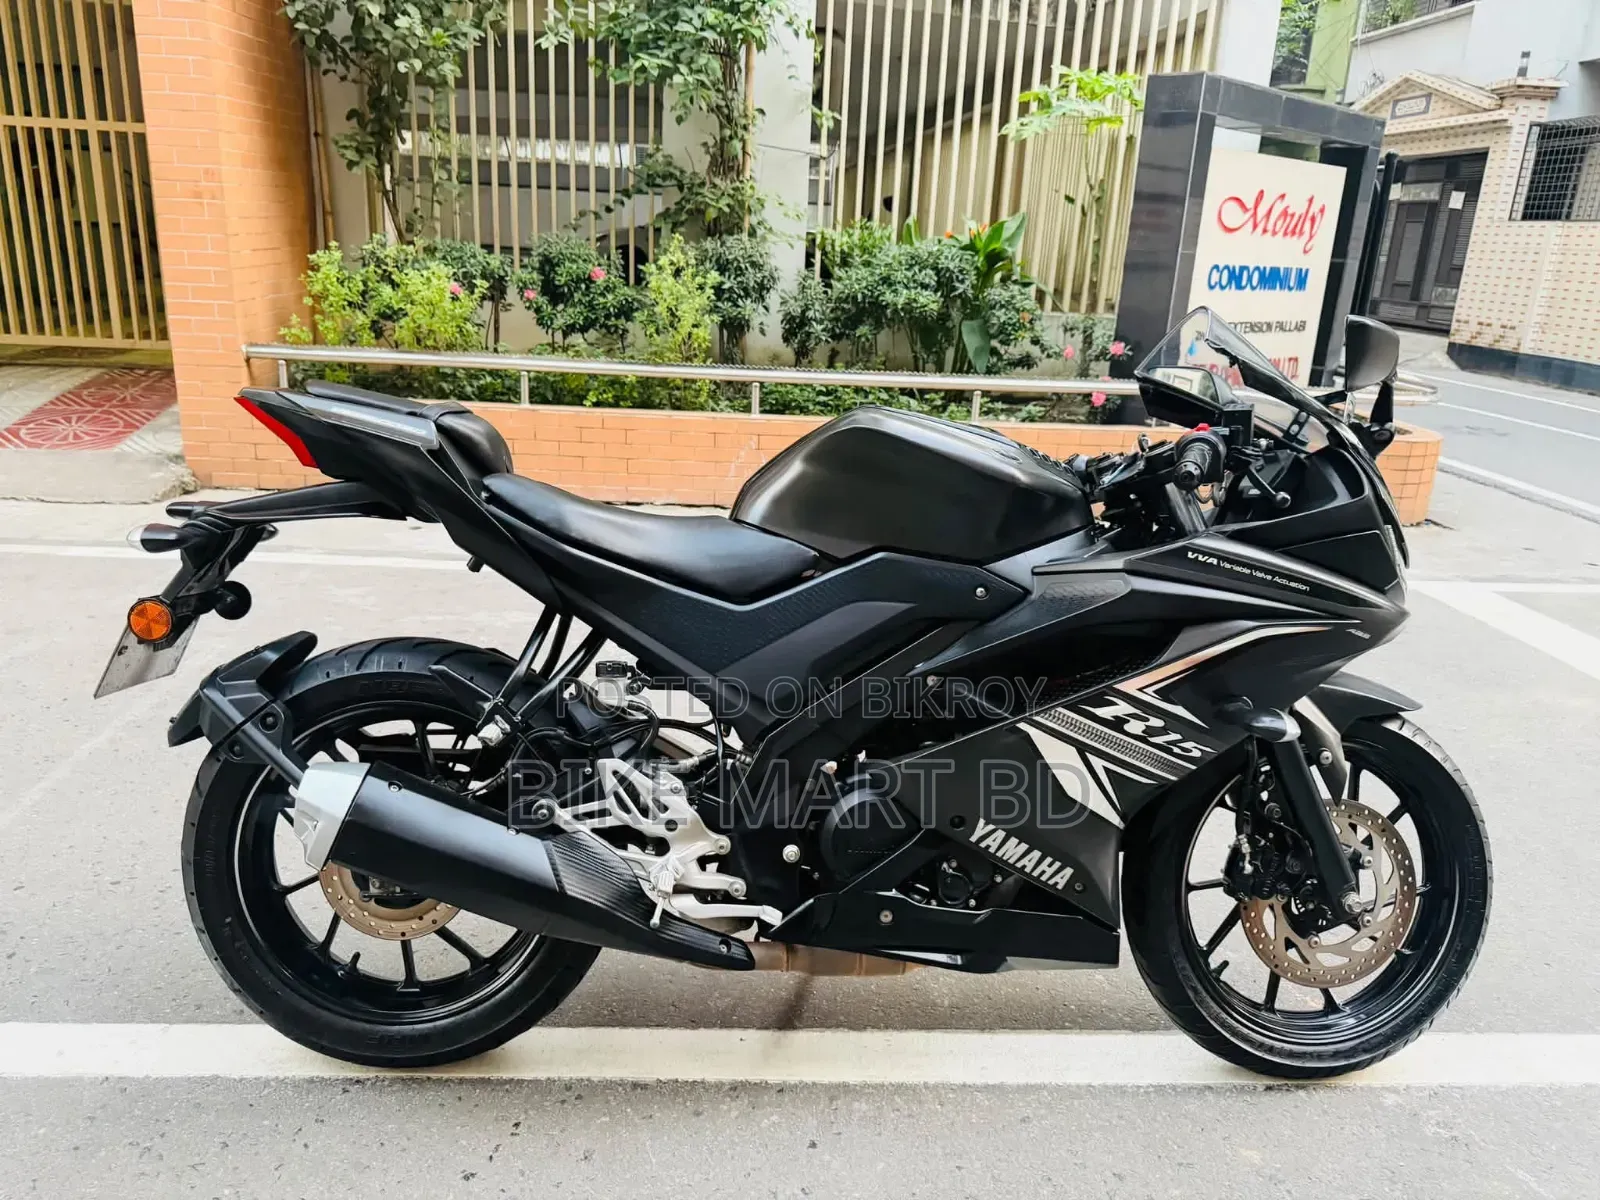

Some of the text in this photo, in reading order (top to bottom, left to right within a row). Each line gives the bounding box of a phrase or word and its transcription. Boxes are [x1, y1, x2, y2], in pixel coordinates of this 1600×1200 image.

[1217, 188, 1326, 256] Mouly
[1207, 263, 1310, 292] CONDOMINIUM
[1187, 551, 1311, 592] VVA Variable Valve Actuation
[1078, 695, 1219, 758] R15
[968, 817, 1075, 891] YAMAHA
